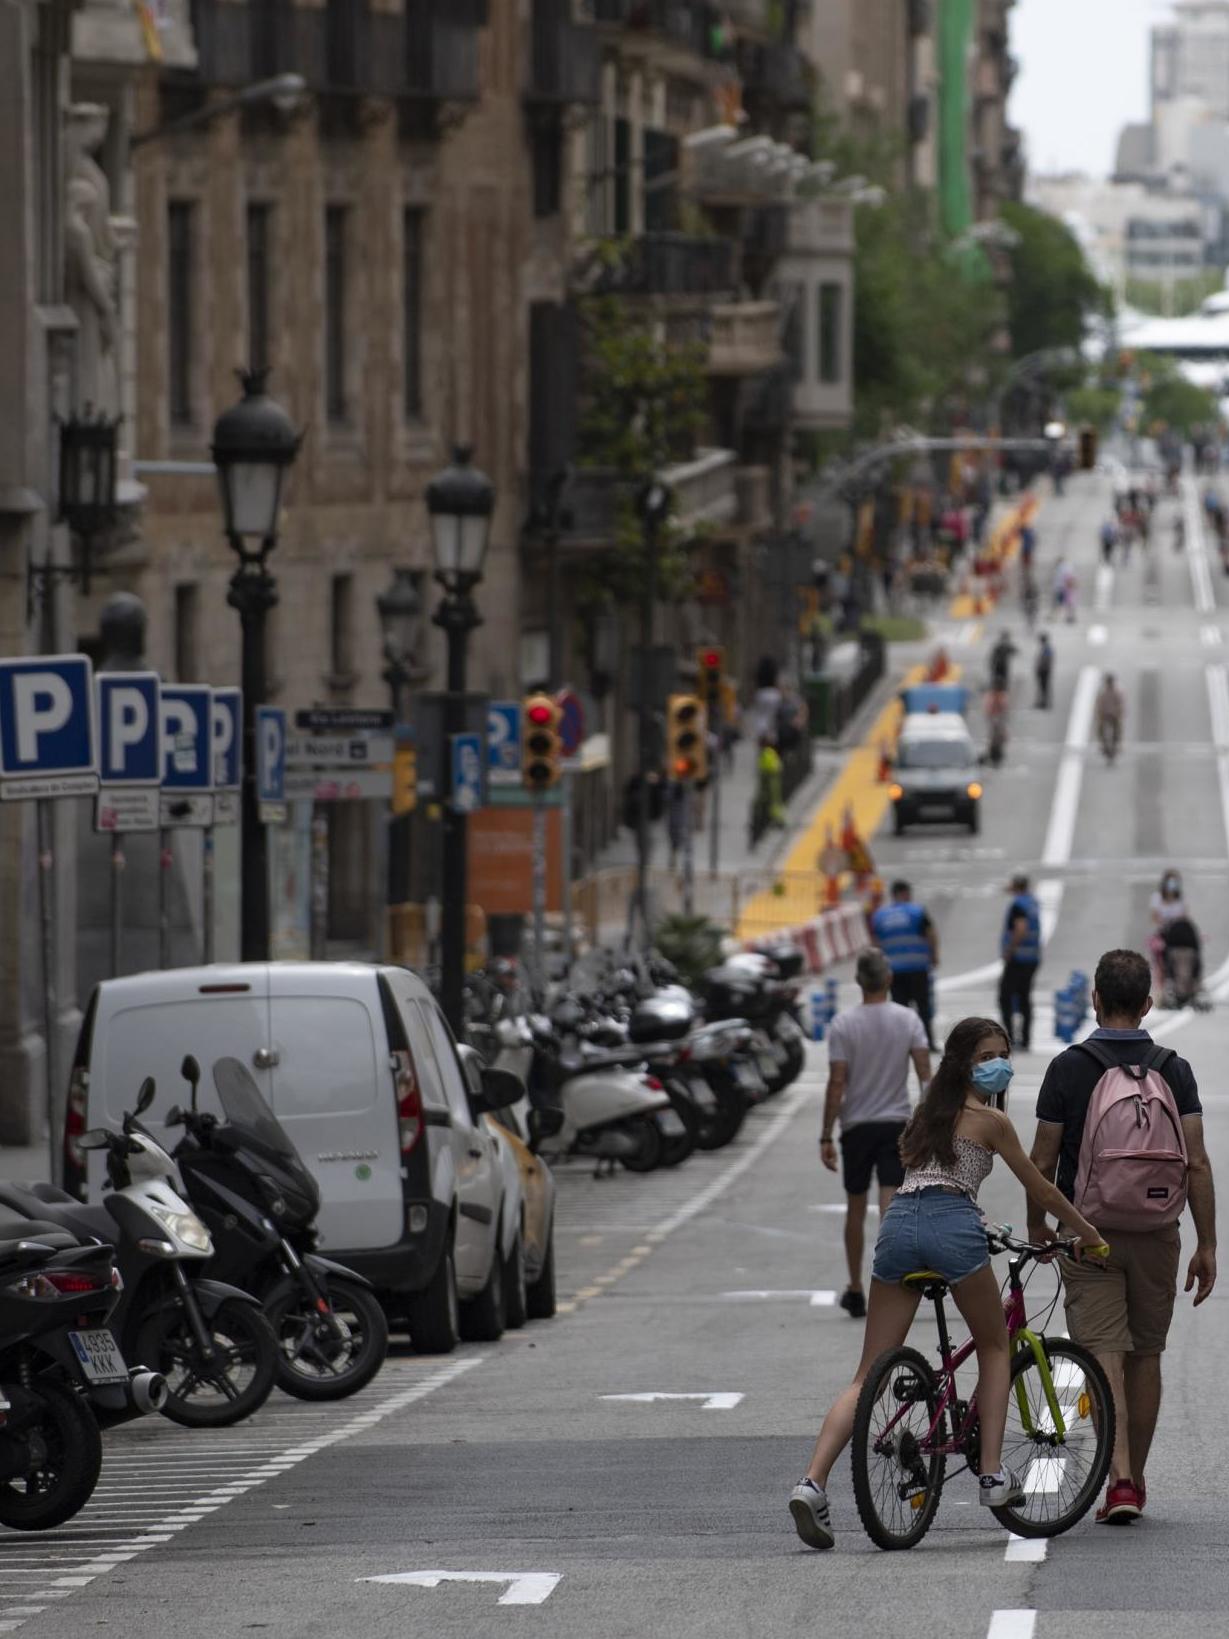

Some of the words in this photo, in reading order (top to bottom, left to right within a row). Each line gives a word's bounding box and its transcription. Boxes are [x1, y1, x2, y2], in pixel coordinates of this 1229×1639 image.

[12, 672, 74, 763] P
[109, 687, 149, 772] P
[80, 1333, 116, 1353] 4935
[90, 1354, 118, 1374] KKK
